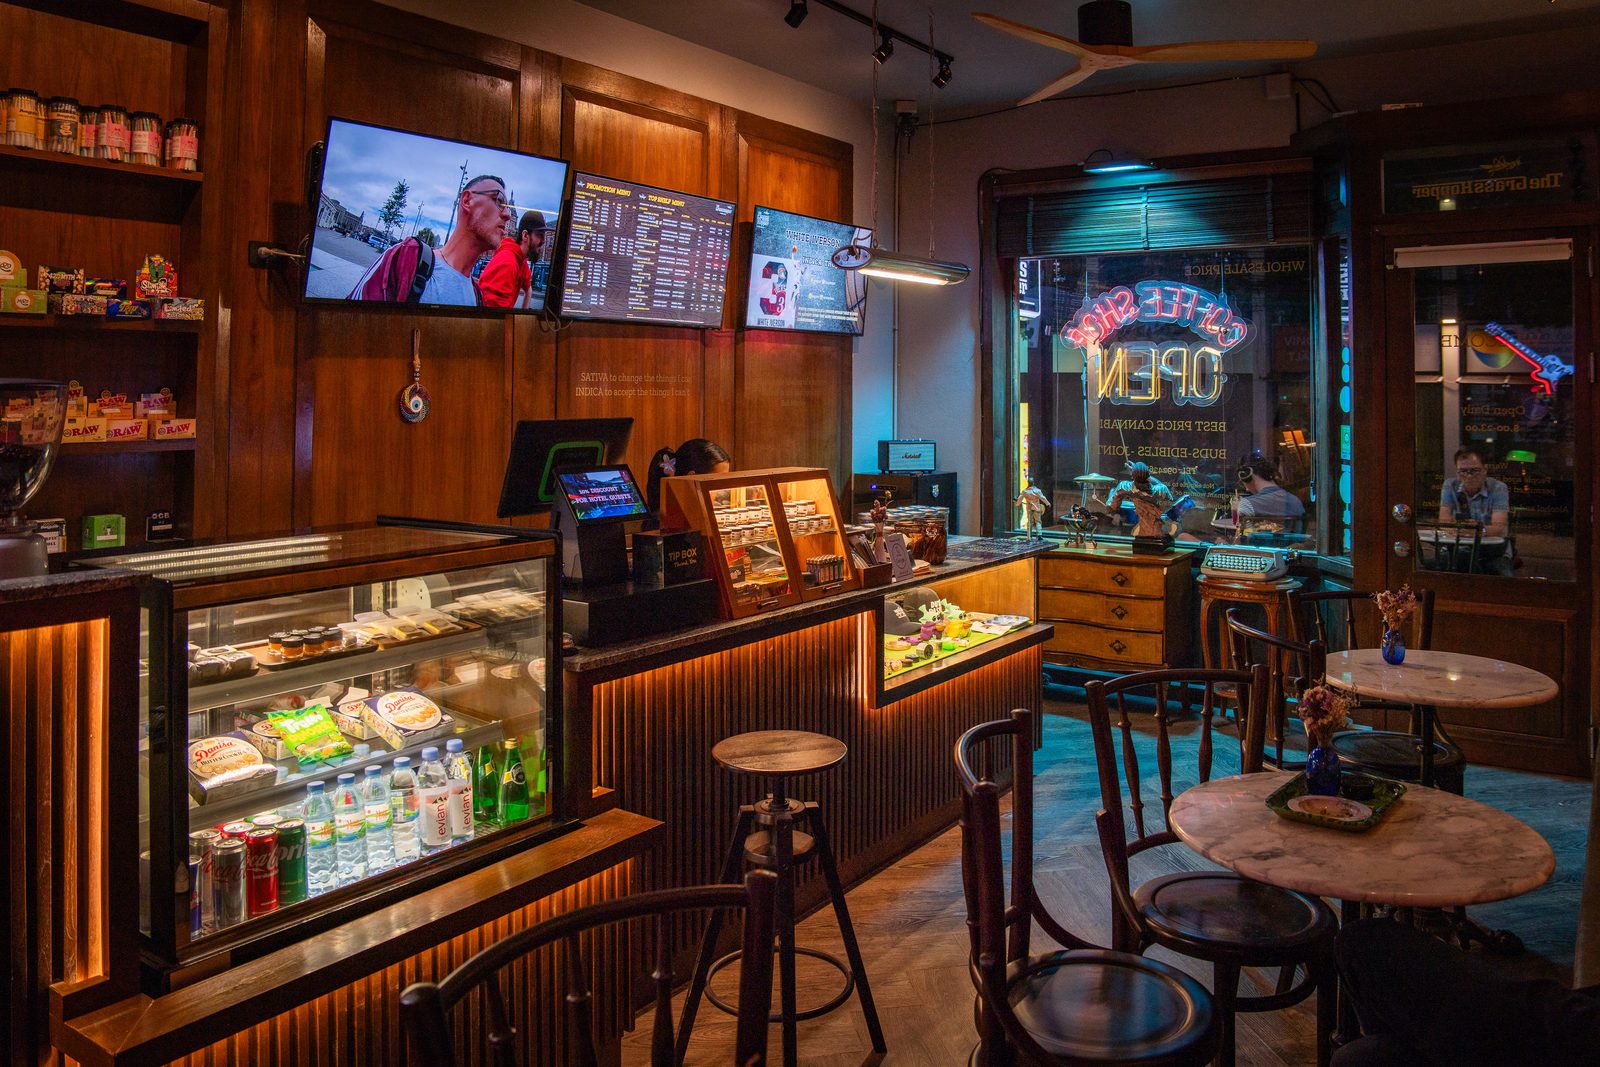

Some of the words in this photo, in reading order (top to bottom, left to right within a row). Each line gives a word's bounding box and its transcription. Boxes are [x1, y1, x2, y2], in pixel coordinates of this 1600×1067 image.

[586, 182, 616, 194] PROMOTION
[616, 188, 631, 197] MENU
[658, 196, 672, 204] SHELF
[786, 230, 810, 242] WHITE
[811, 234, 840, 248] IVERSON
[580, 372, 608, 381] SATIVA
[619, 373, 643, 384] change
[656, 374, 677, 384] things
[576, 387, 604, 396] INDICA
[613, 388, 636, 398] accept
[649, 388, 670, 398] things
[98, 396, 125, 407] RAW
[143, 397, 171, 408] RAW
[72, 425, 100, 436] RAW
[113, 425, 141, 437] RAW
[166, 424, 190, 435] RAW
[669, 552, 680, 560] TIP
[682, 548, 697, 559] BOX
[385, 696, 416, 713] Danisa
[280, 711, 323, 734] Trolli
[195, 741, 237, 762] Danisa
[463, 794, 471, 825] evian
[436, 803, 446, 836] evian
